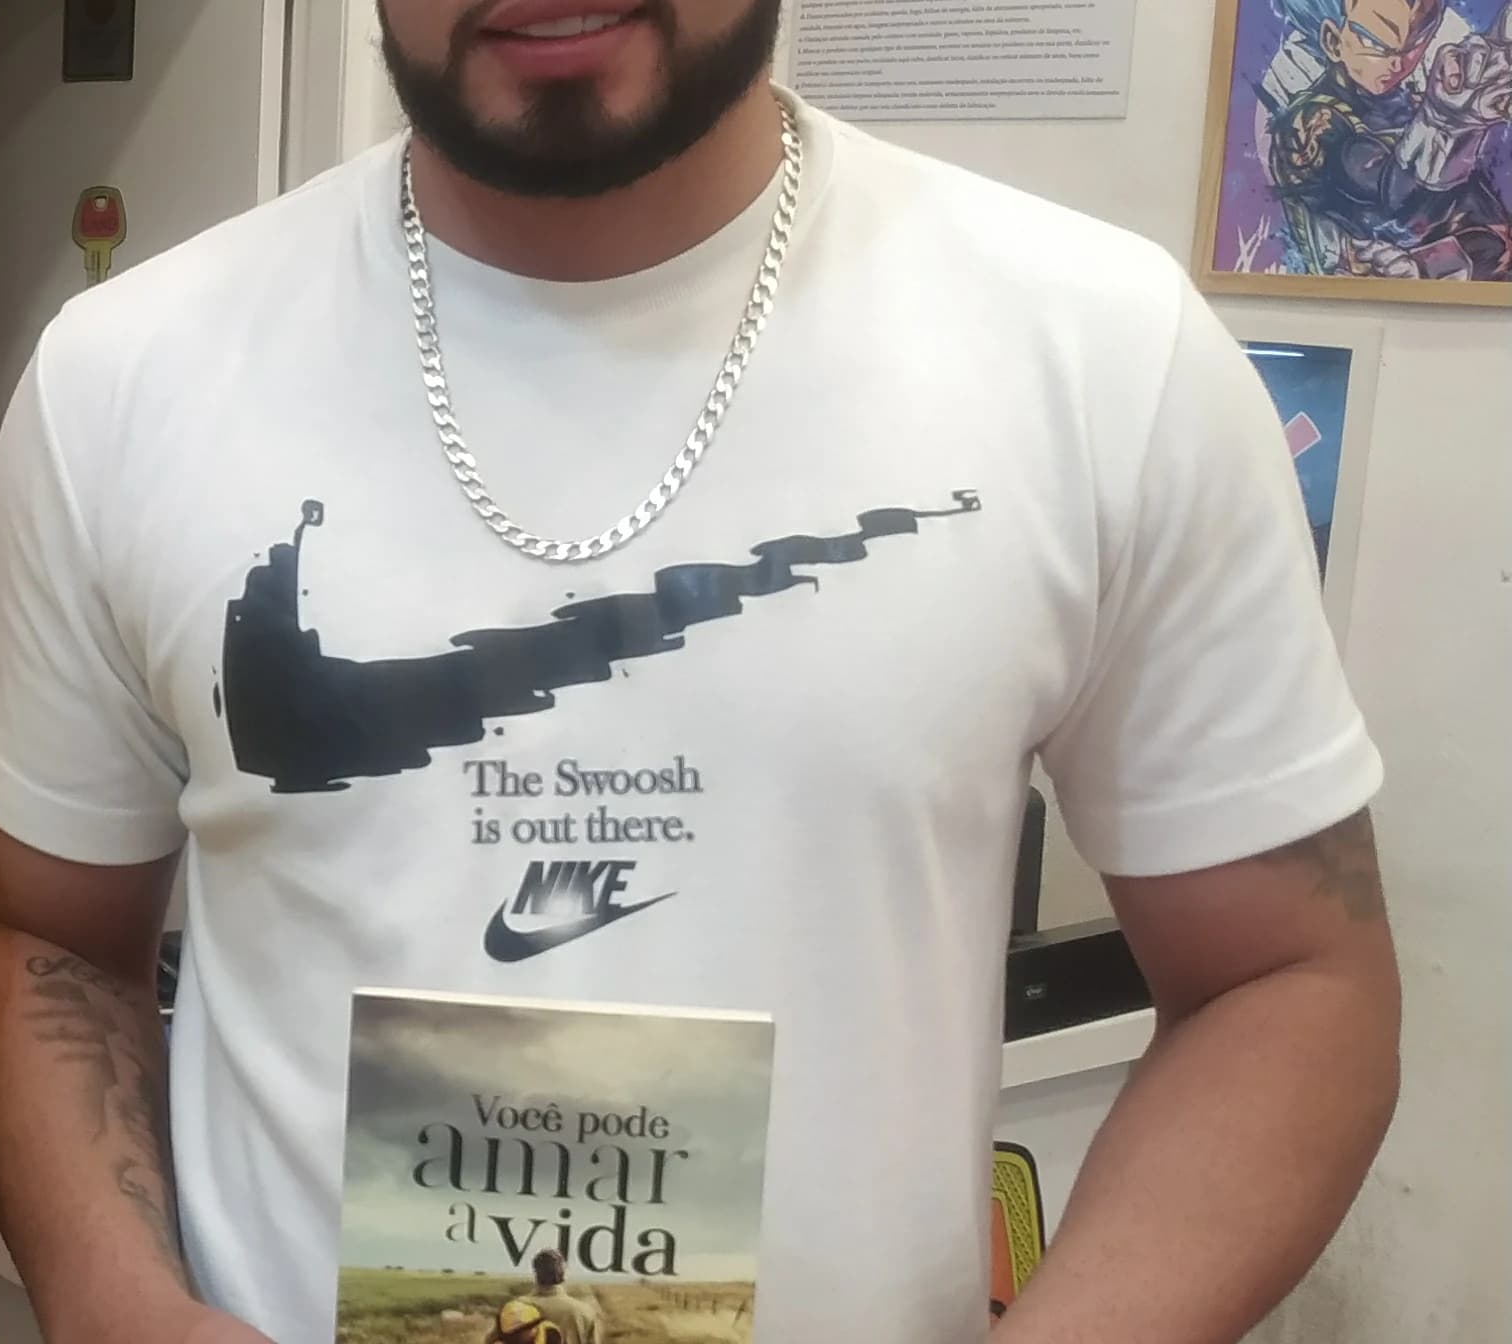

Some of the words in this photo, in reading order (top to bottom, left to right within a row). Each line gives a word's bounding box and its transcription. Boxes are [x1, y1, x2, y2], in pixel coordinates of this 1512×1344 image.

[462, 759, 544, 798] The
[554, 754, 704, 798] Swoosh
[471, 806, 501, 845] is
[511, 812, 578, 845] out
[585, 805, 695, 845] there.
[510, 860, 638, 916] NIKE
[472, 1093, 564, 1134] Você
[576, 1105, 670, 1144] pode
[412, 1121, 690, 1205] amar
[444, 1201, 479, 1245] a
[487, 1203, 680, 1277] vida
